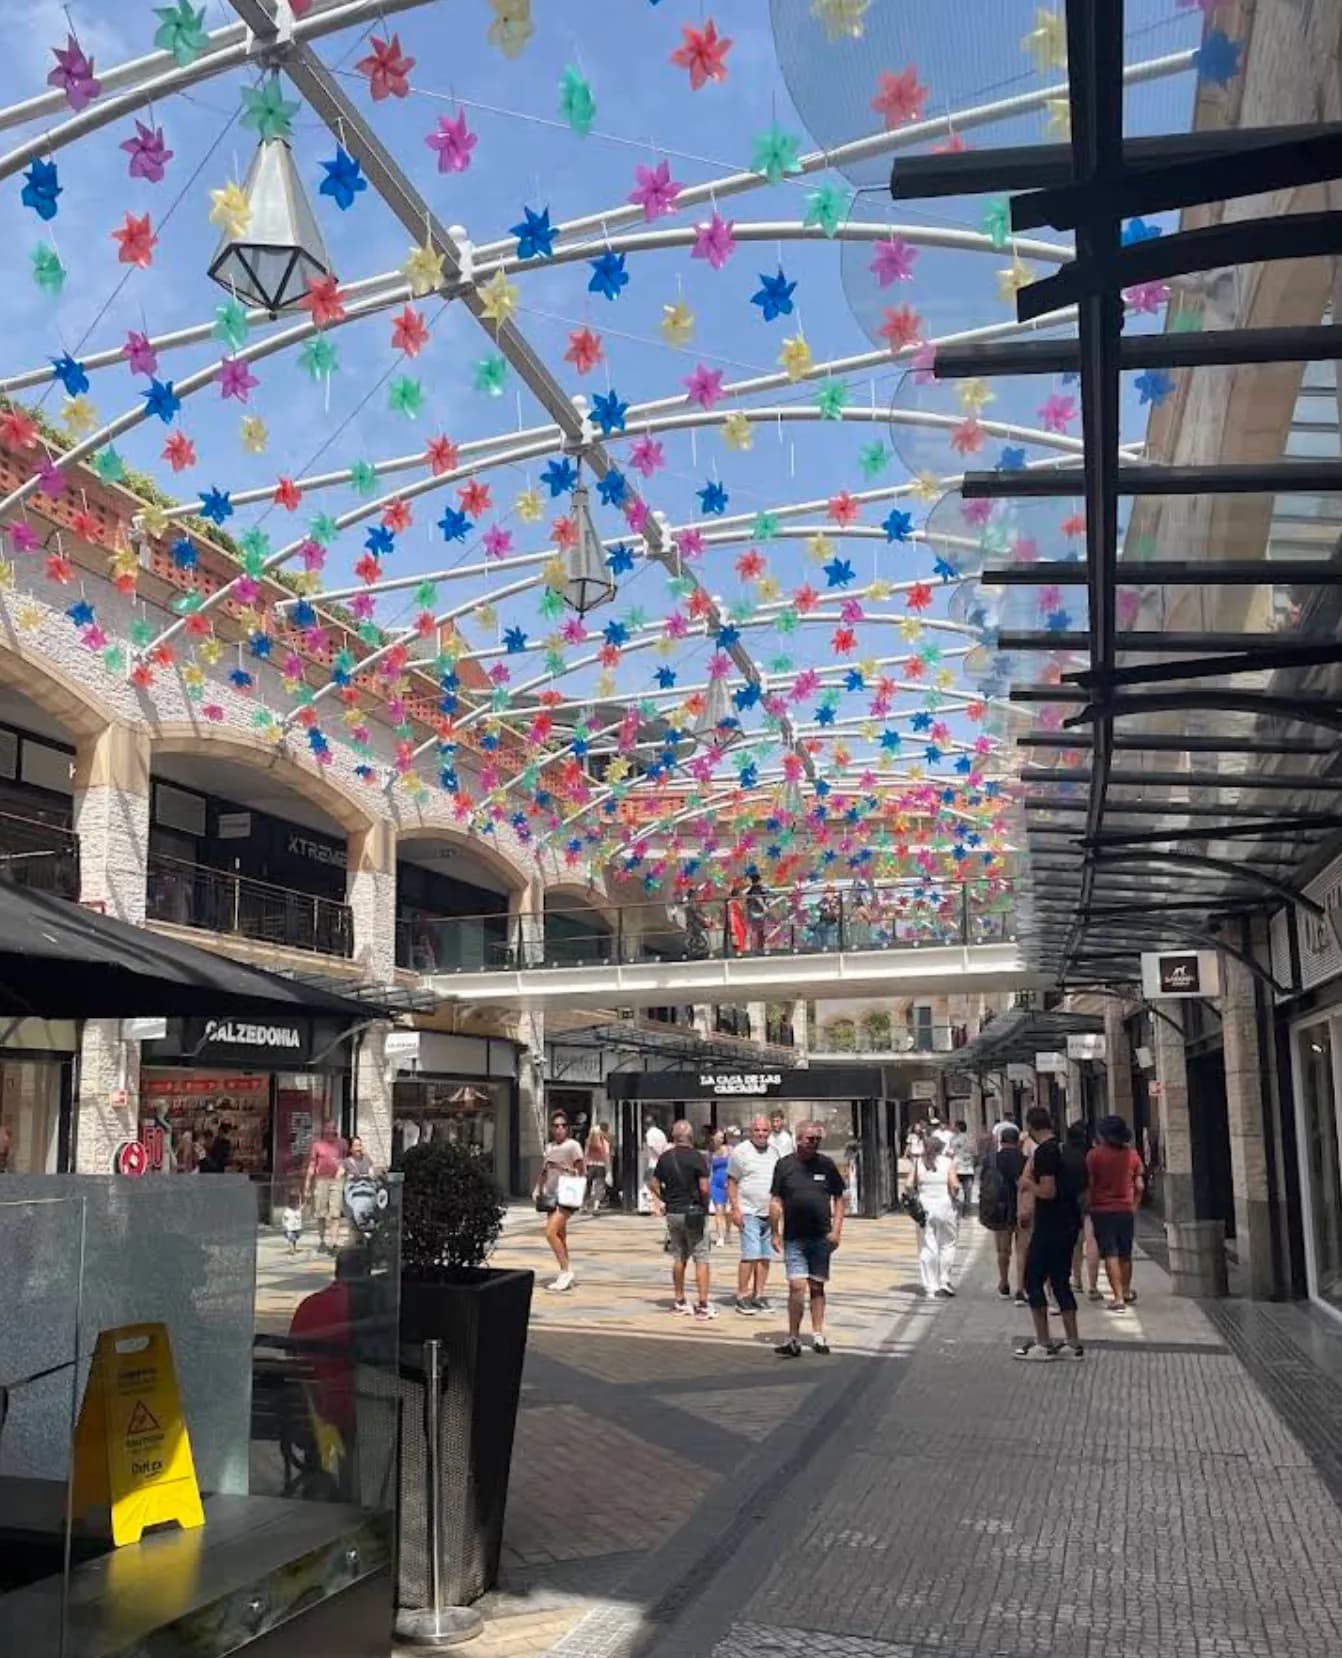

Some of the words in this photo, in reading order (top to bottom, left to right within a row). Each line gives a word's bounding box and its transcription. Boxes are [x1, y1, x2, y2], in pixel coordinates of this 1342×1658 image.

[205, 1020, 300, 1047] CALZEDONIA
[700, 1074, 715, 1085] LA
[759, 1074, 781, 1085] LAS
